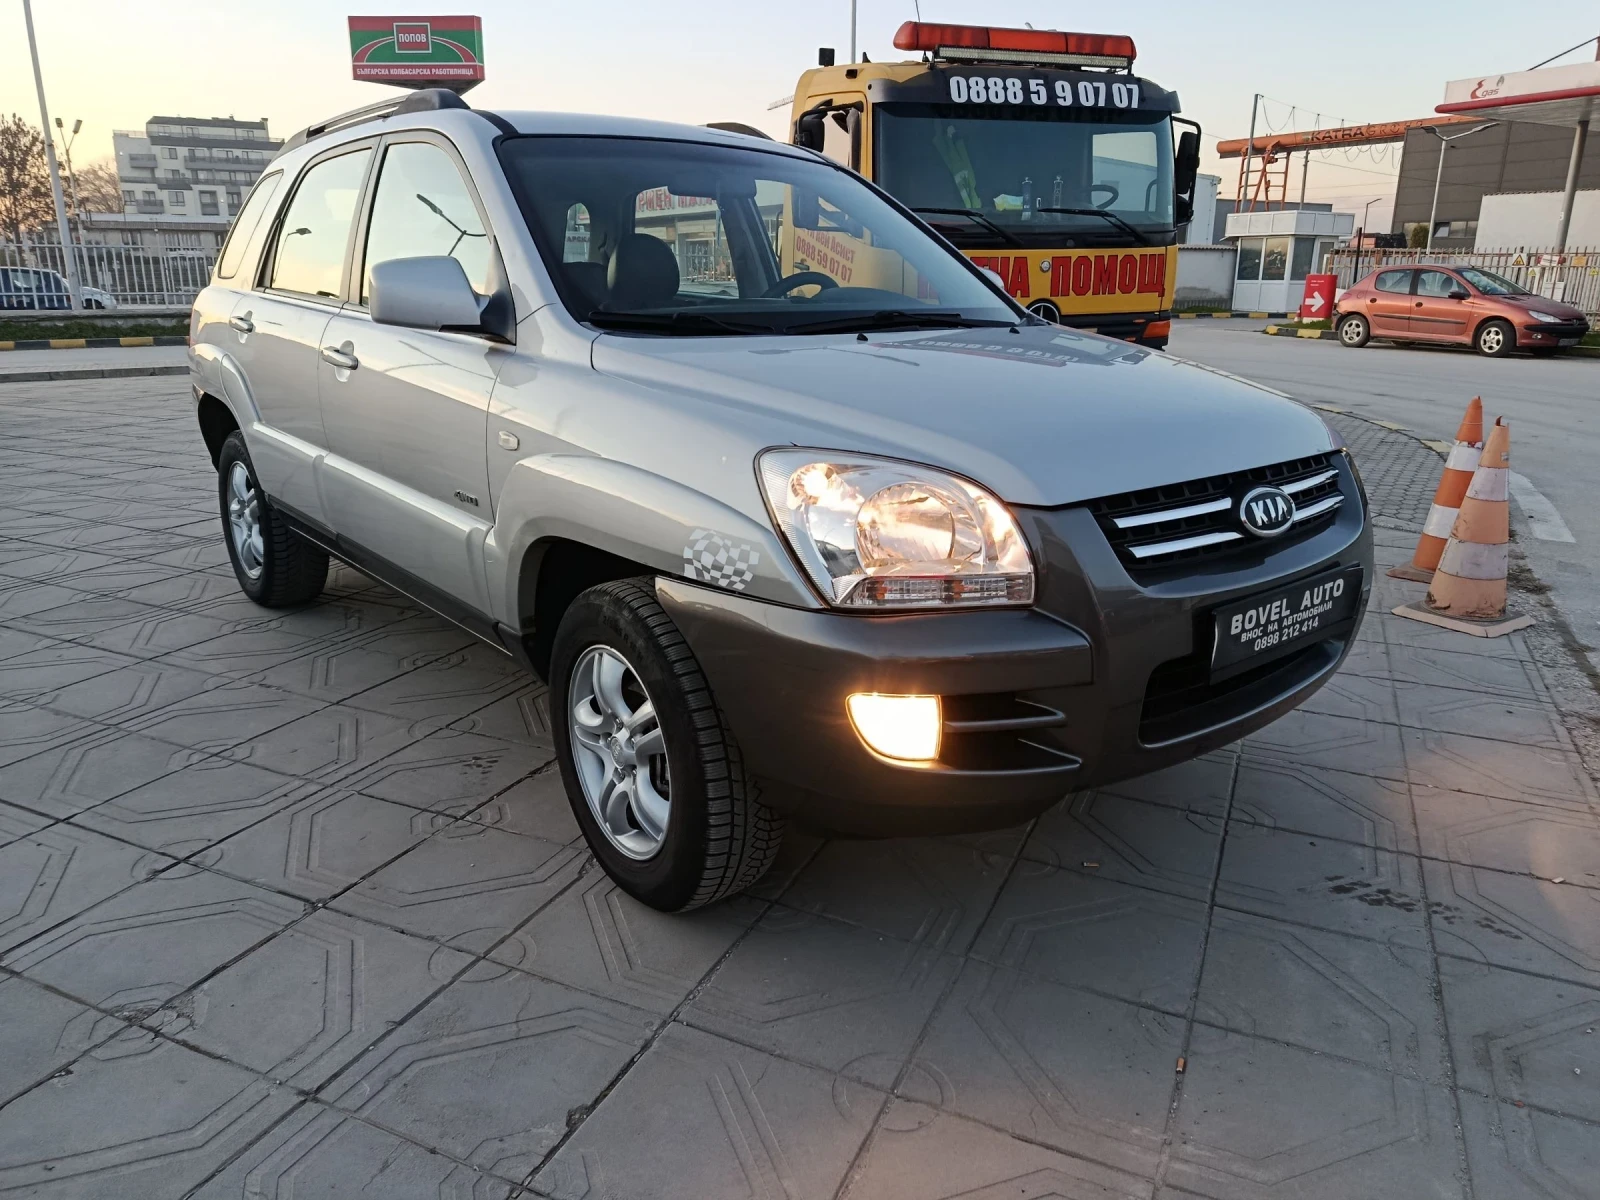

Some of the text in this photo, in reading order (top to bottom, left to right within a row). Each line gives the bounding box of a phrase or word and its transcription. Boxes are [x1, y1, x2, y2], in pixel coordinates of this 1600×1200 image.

[398, 33, 427, 43] ПОПОВ
[356, 68, 474, 76] БЪЛГАРСКА КОЛБАСАРСКА РАБОТИЛНИЦА
[950, 76, 1024, 104] 0888
[1078, 81, 1107, 107] 07
[1111, 82, 1140, 109] 07
[796, 235, 853, 284] 0888 59 07 07
[1050, 253, 1165, 298] ПОМОЩ
[1249, 496, 1291, 527] KIA
[1230, 578, 1344, 635] BOVEL AUTO
[1240, 600, 1333, 643] ВНОС НА АВТОМОБИЛИ
[1254, 616, 1319, 651] 0898 212 414
